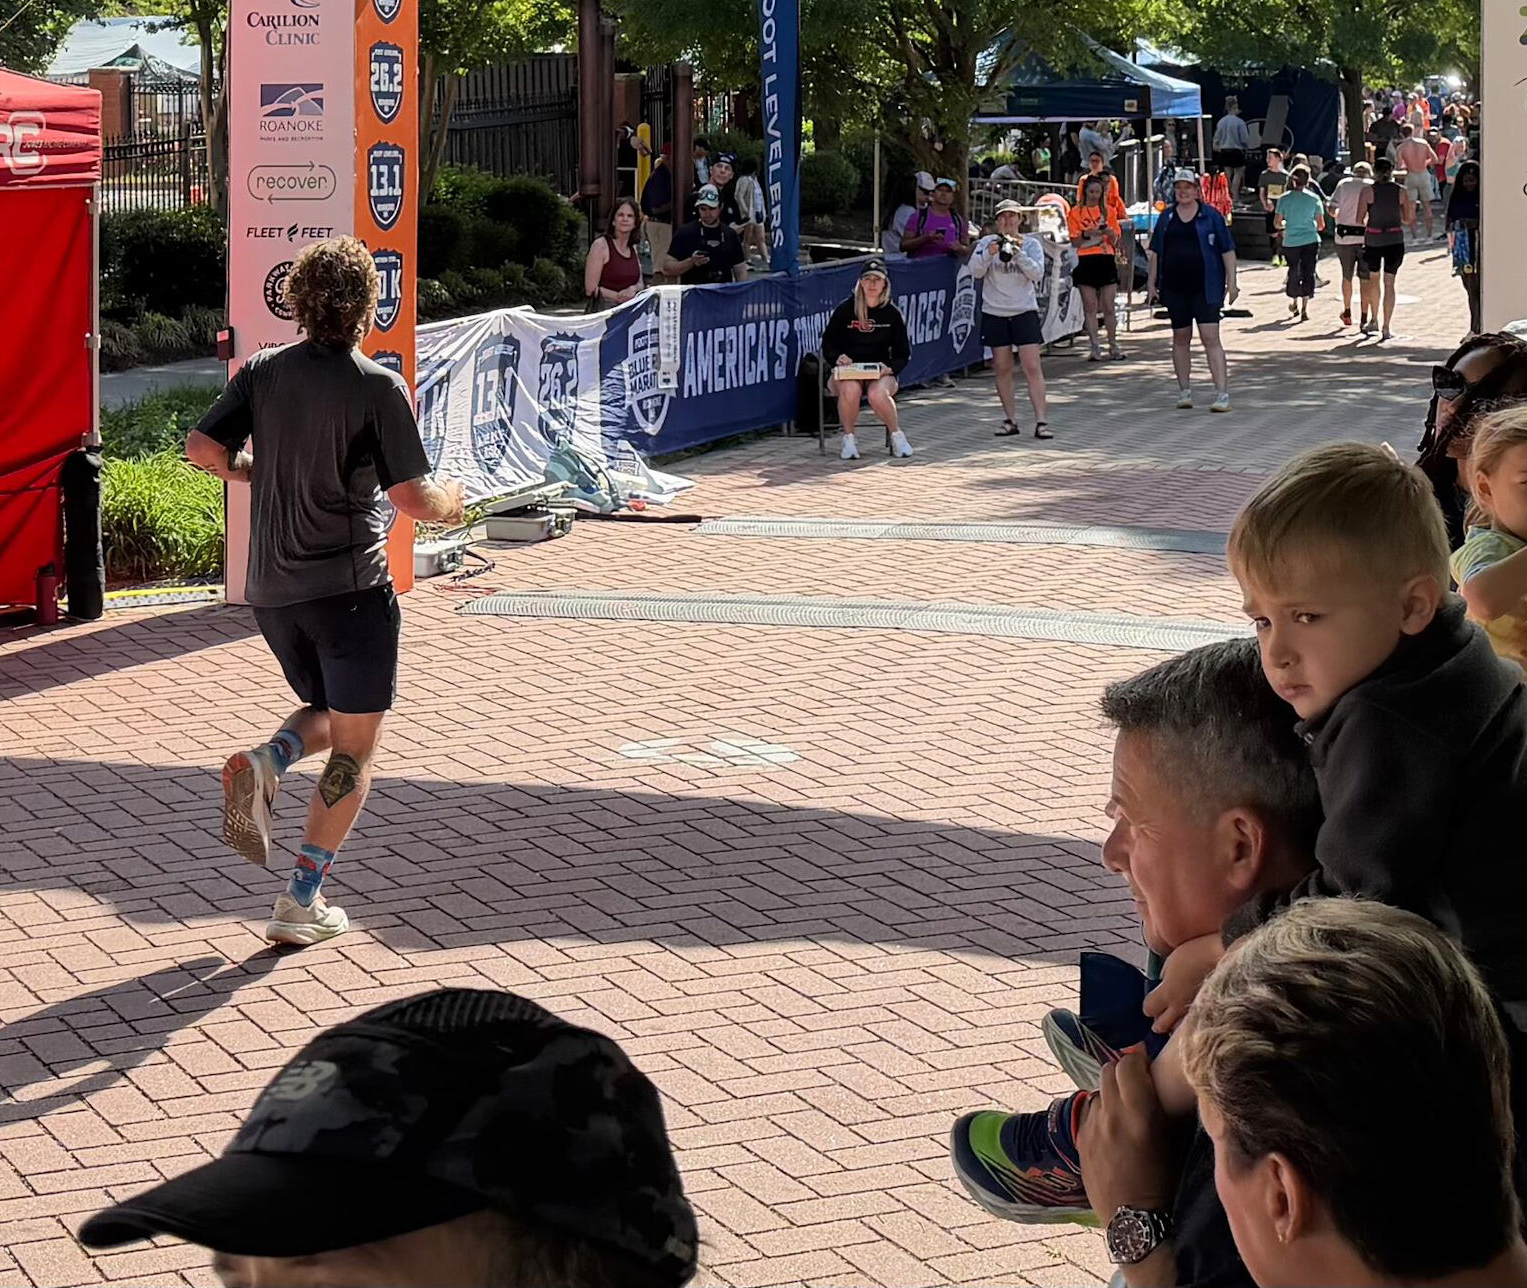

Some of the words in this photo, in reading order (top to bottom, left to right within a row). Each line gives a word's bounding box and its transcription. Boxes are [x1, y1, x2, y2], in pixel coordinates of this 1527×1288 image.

[247, 11, 320, 29] CARILION
[265, 29, 321, 46] CLINIC
[370, 61, 403, 93] 26.2
[259, 120, 324, 132] ROANOKE
[764, 73, 785, 249] LEVELERS
[256, 176, 328, 189] recover
[370, 164, 402, 196] 13.1
[246, 227, 284, 238] FLEET
[301, 227, 334, 238] FEET
[628, 355, 650, 379] BLUE
[682, 318, 790, 399] AMERICA'S
[475, 366, 513, 422] 131
